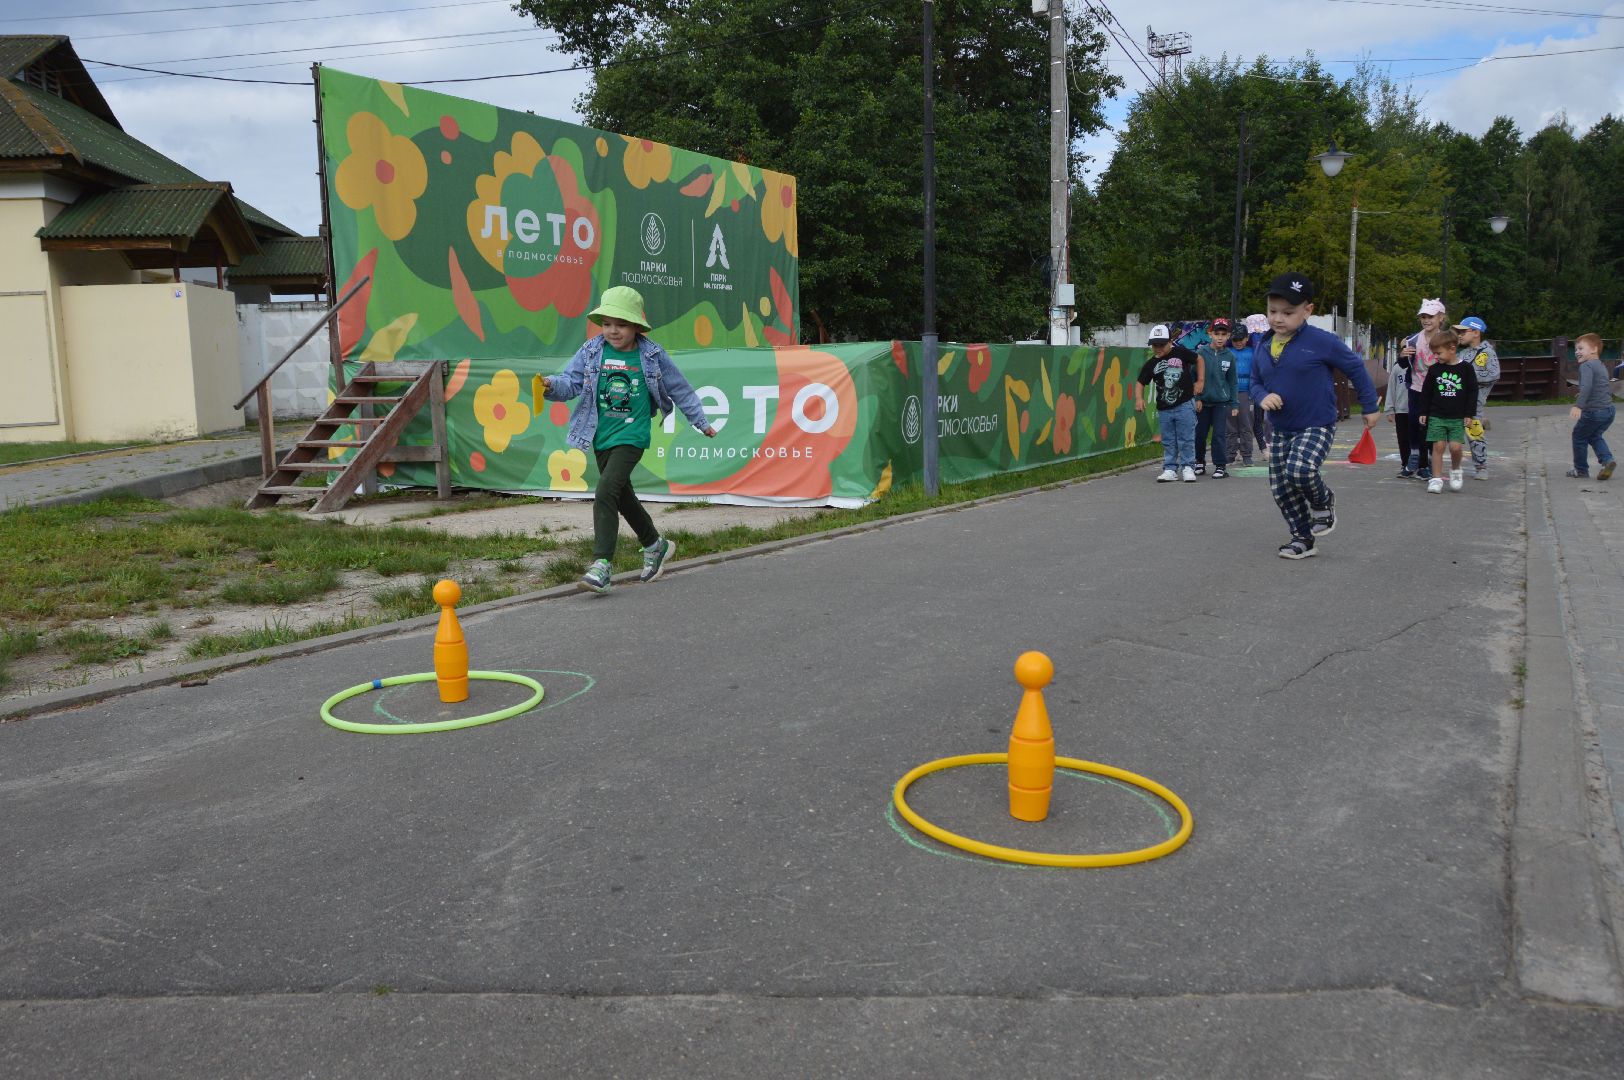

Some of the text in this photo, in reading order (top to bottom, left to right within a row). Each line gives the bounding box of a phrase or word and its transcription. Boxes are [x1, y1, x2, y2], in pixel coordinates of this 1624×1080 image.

[508, 250, 583, 265] ПОДМОСКОВЬЕ
[640, 260, 667, 273] ПАРКИ
[621, 271, 683, 287] ПОДМОСКОВЬЯ
[710, 273, 727, 283] ПАРК
[937, 395, 958, 413] РКИ
[657, 447, 813, 460] В ПОДМОСКОВЬЕ
